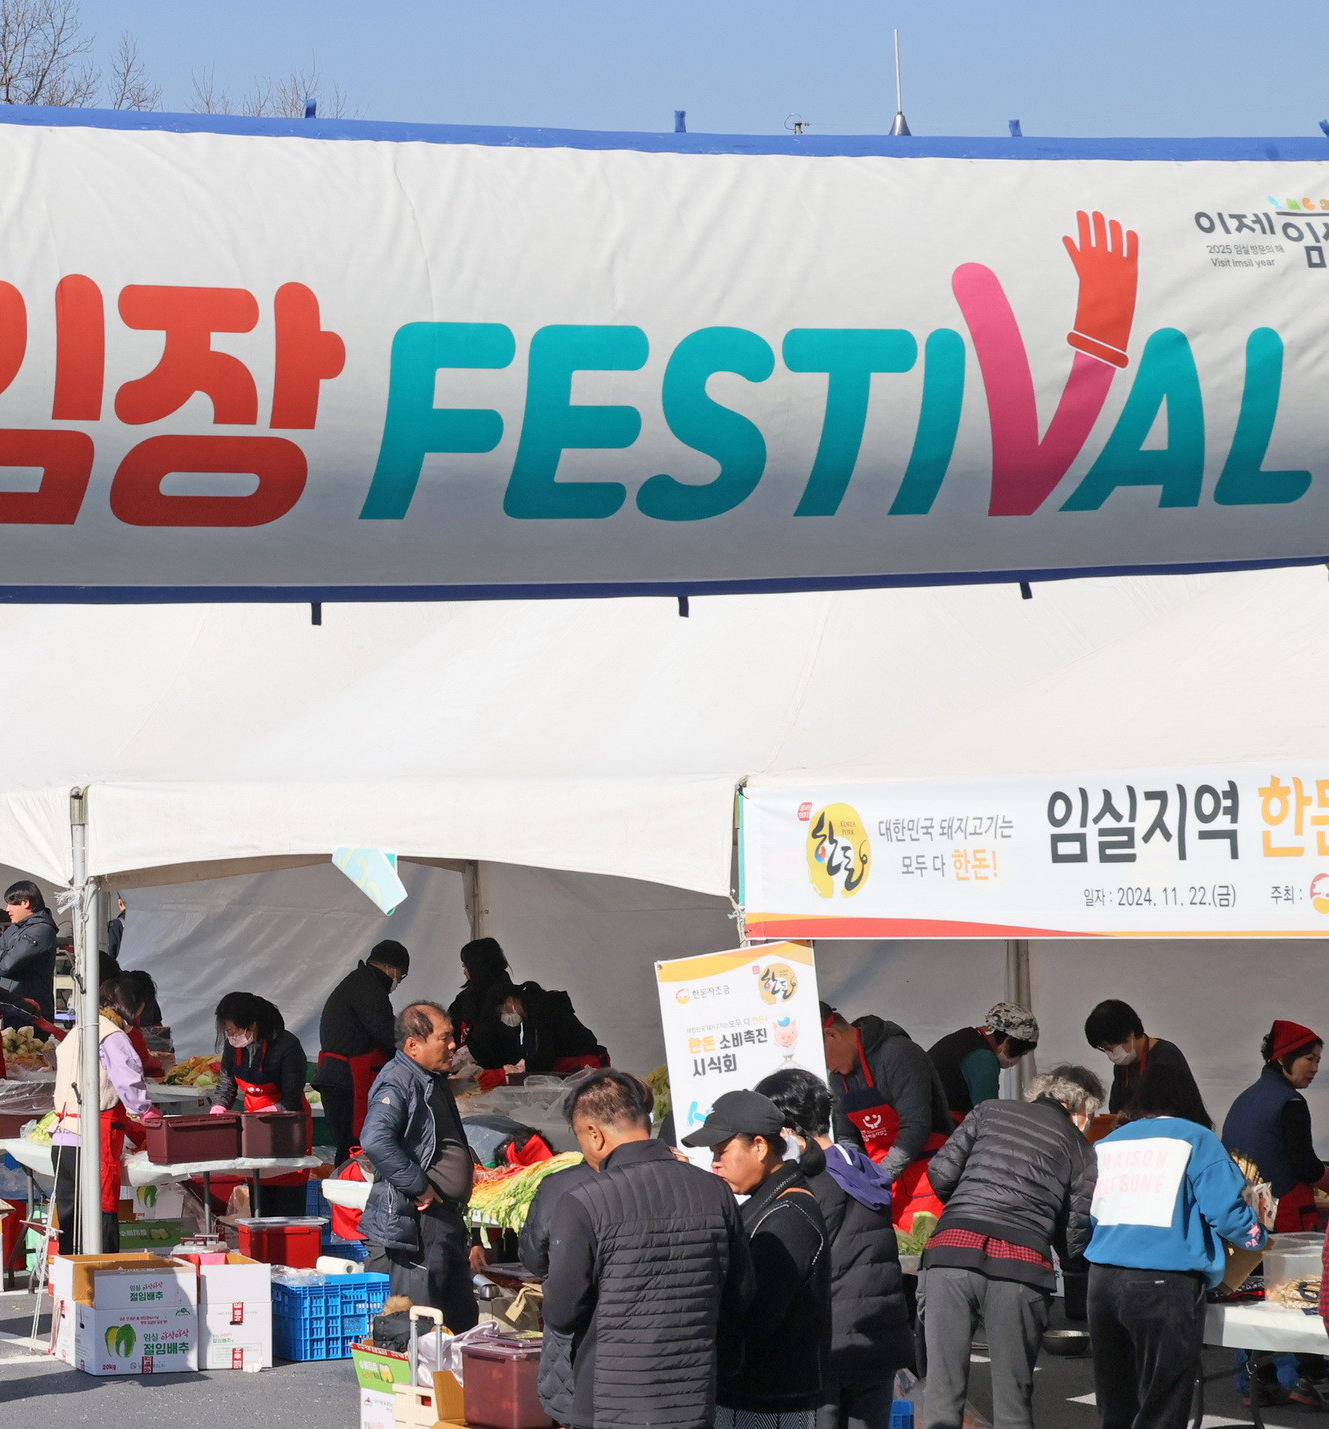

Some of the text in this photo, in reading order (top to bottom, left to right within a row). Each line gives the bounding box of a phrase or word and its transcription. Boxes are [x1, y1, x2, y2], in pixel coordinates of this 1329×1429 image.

[1194, 211, 1276, 235] 이제
[1207, 245, 1233, 254] 2025
[1234, 245, 1250, 255] 임실
[1251, 245, 1274, 255] 방문의
[1211, 258, 1275, 268] Visit Imsil year
[358, 240, 1312, 521] FESTIVAL
[878, 815, 1014, 842] 대한민국 돼지고기는
[1047, 780, 1240, 864] 임실지역
[901, 849, 998, 881] 모두 다 한돈!
[1084, 889, 1106, 907] 일자
[1117, 887, 1157, 907] 2024.
[1271, 885, 1295, 904] 주최
[692, 985, 730, 1000] 한돈자조금
[688, 1028, 768, 1054] 한돈 소비촉진
[692, 1054, 737, 1077] 시식회
[1101, 1149, 1168, 1170] MAISON
[130, 1291, 163, 1302] 절임배추
[143, 1333, 159, 1342] 임실
[143, 1342, 189, 1356] 절임배추
[102, 1363, 117, 1371] 20kg
